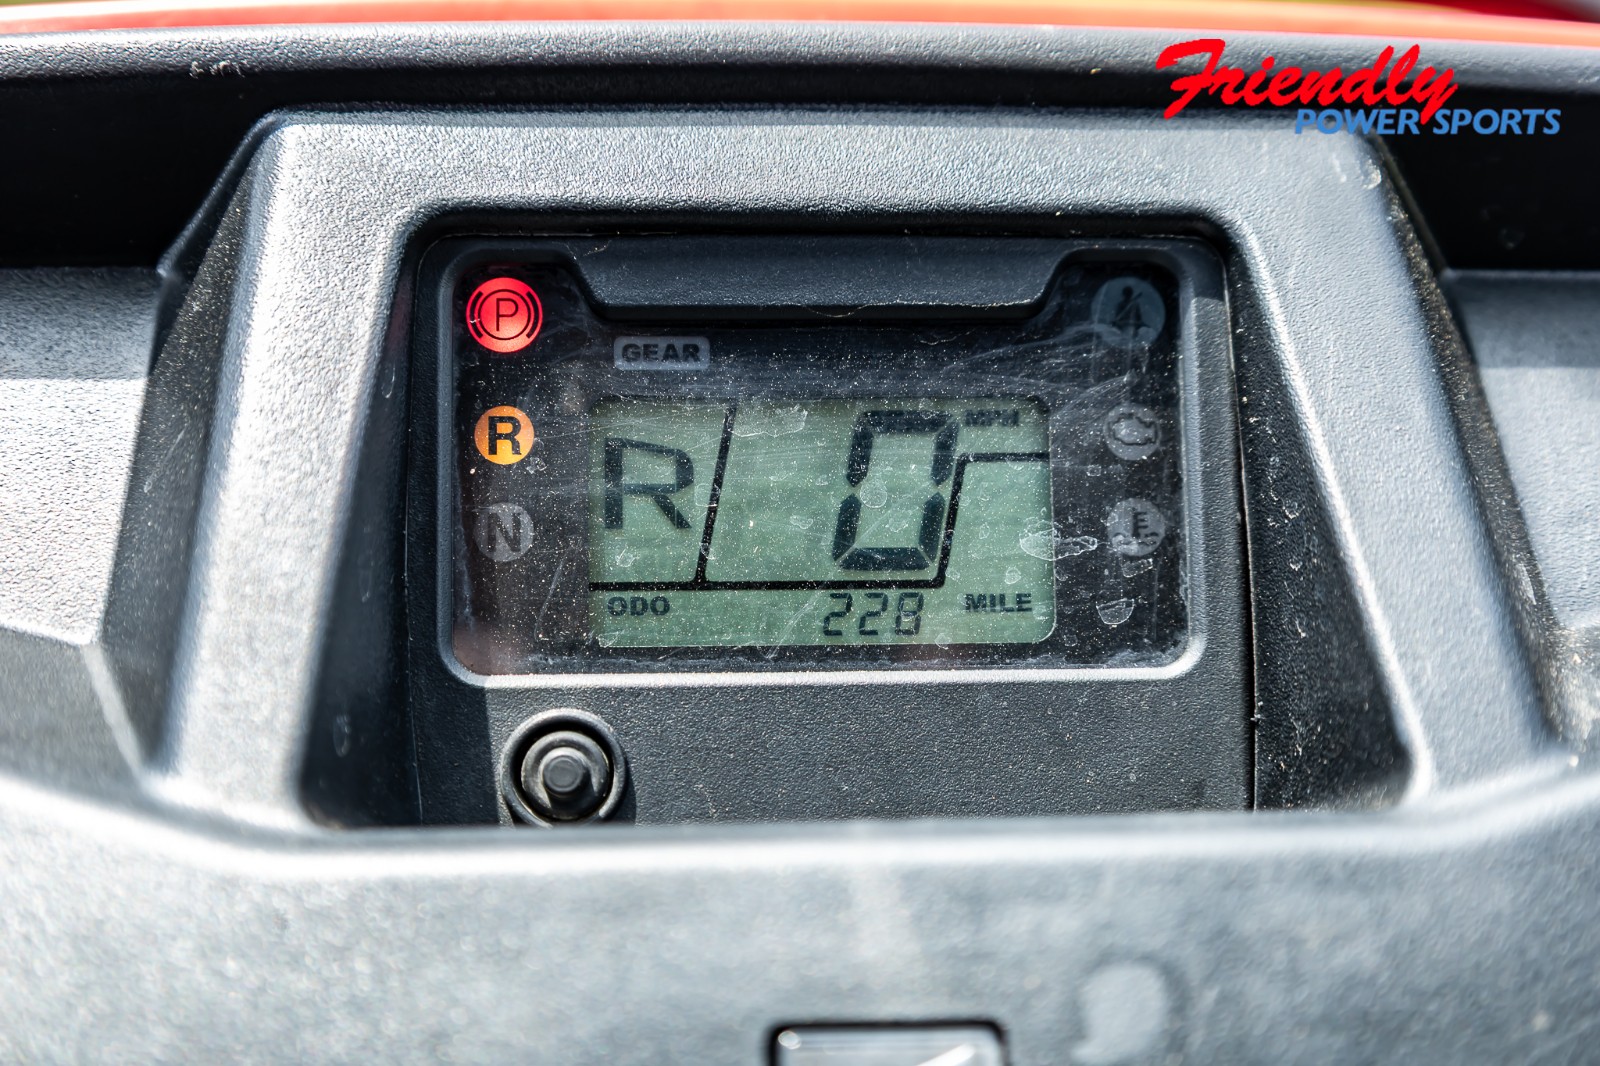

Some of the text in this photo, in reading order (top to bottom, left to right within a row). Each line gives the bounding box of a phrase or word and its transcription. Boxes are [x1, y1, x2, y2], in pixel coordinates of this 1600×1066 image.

[495, 297, 519, 332] P
[620, 343, 701, 363] GEAR
[487, 416, 521, 455] R
[964, 409, 1019, 427] MPH
[604, 438, 694, 529] R
[831, 410, 960, 571] 0
[486, 511, 522, 553] N
[607, 596, 671, 616] ODO
[823, 592, 924, 636] 228
[965, 593, 1032, 612] MILE
